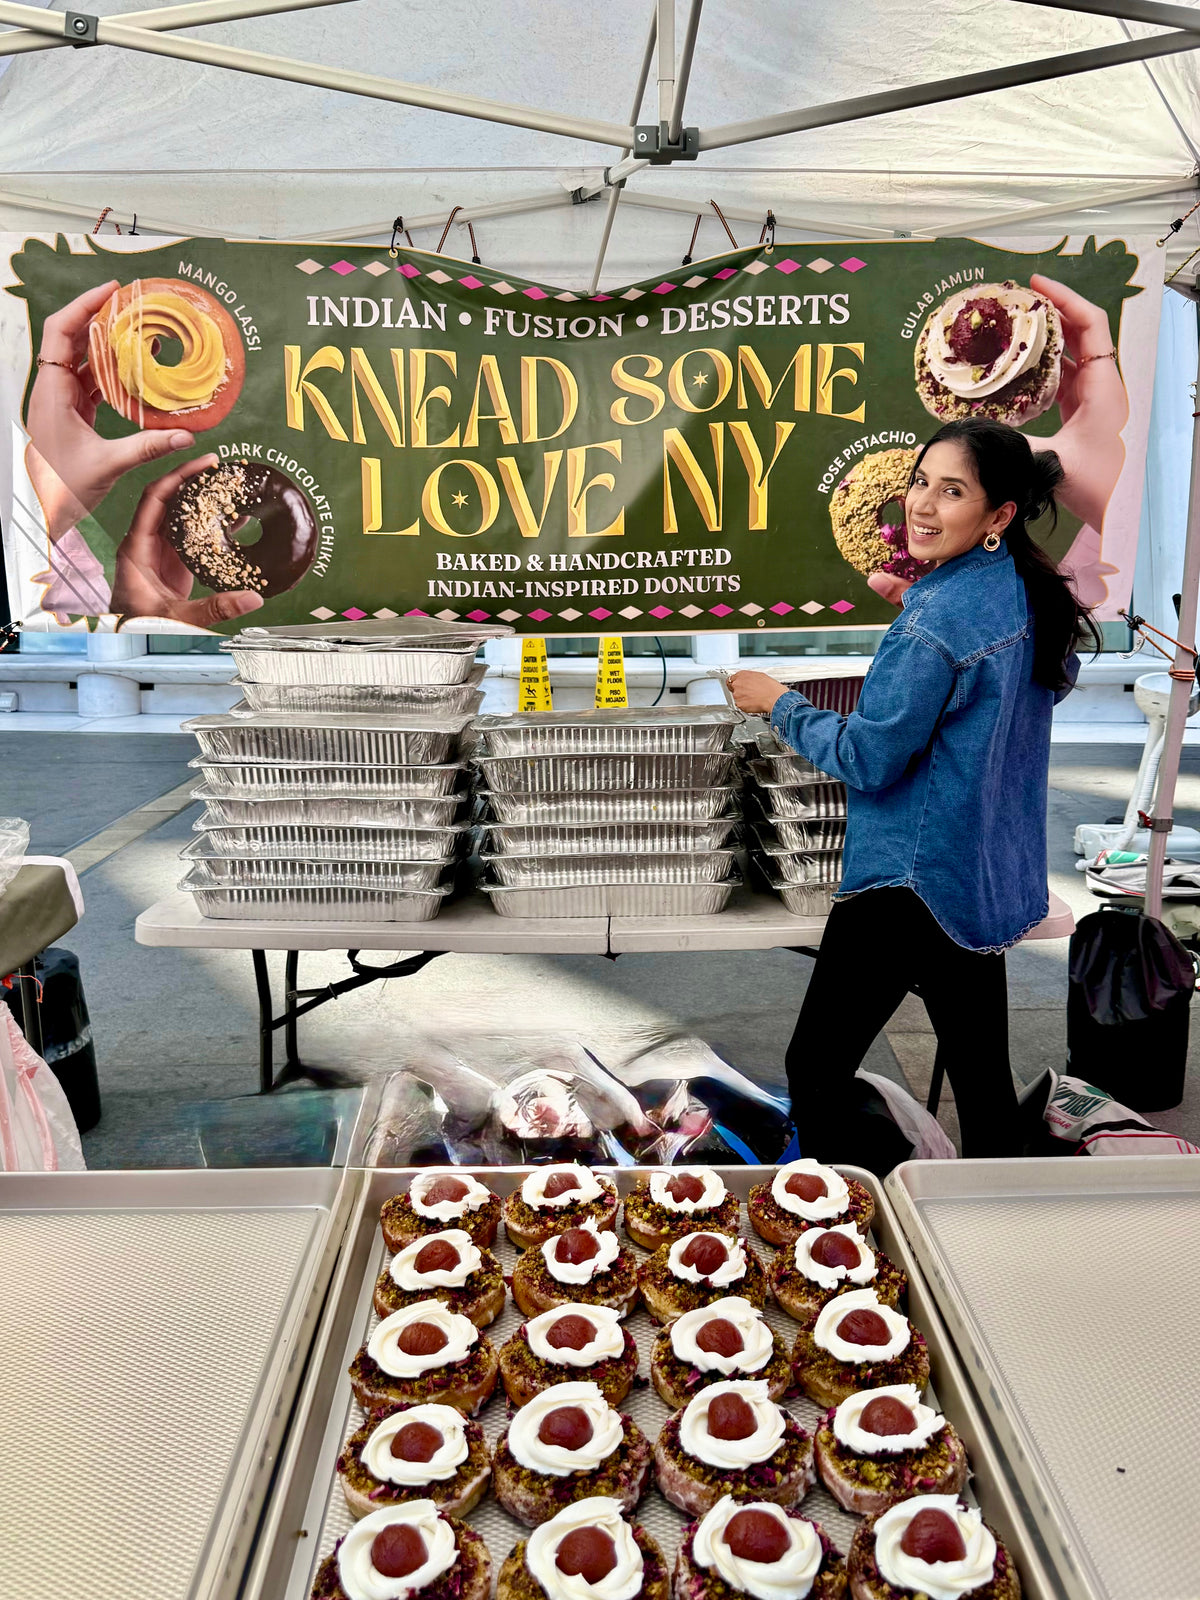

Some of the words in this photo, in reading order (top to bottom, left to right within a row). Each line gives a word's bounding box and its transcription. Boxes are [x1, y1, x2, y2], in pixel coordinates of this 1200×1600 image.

[178, 261, 237, 303] MANGO
[234, 305, 262, 351] LASSI
[306, 295, 447, 331] INDIAN
[483, 306, 625, 339] FUSION
[660, 293, 850, 335] DESSERTS
[900, 292, 934, 339] GULAB
[934, 267, 984, 296] JAMUN
[284, 345, 579, 448] KNEAD
[610, 342, 866, 425] SOME
[361, 439, 625, 538] LOVE
[663, 421, 796, 534] NY
[817, 457, 846, 493] ROSE
[842, 431, 916, 460] PISTACHIO
[218, 443, 263, 459] DARK
[266, 449, 333, 521] CHOCOLATE
[312, 525, 335, 577] CHIKKI
[427, 578, 640, 598] INDIAN-INSPIRED
[644, 575, 741, 595] DONUTS
[436, 552, 521, 572] BAKED
[526, 553, 545, 572] &
[549, 548, 732, 572] HANDCRAFTED
